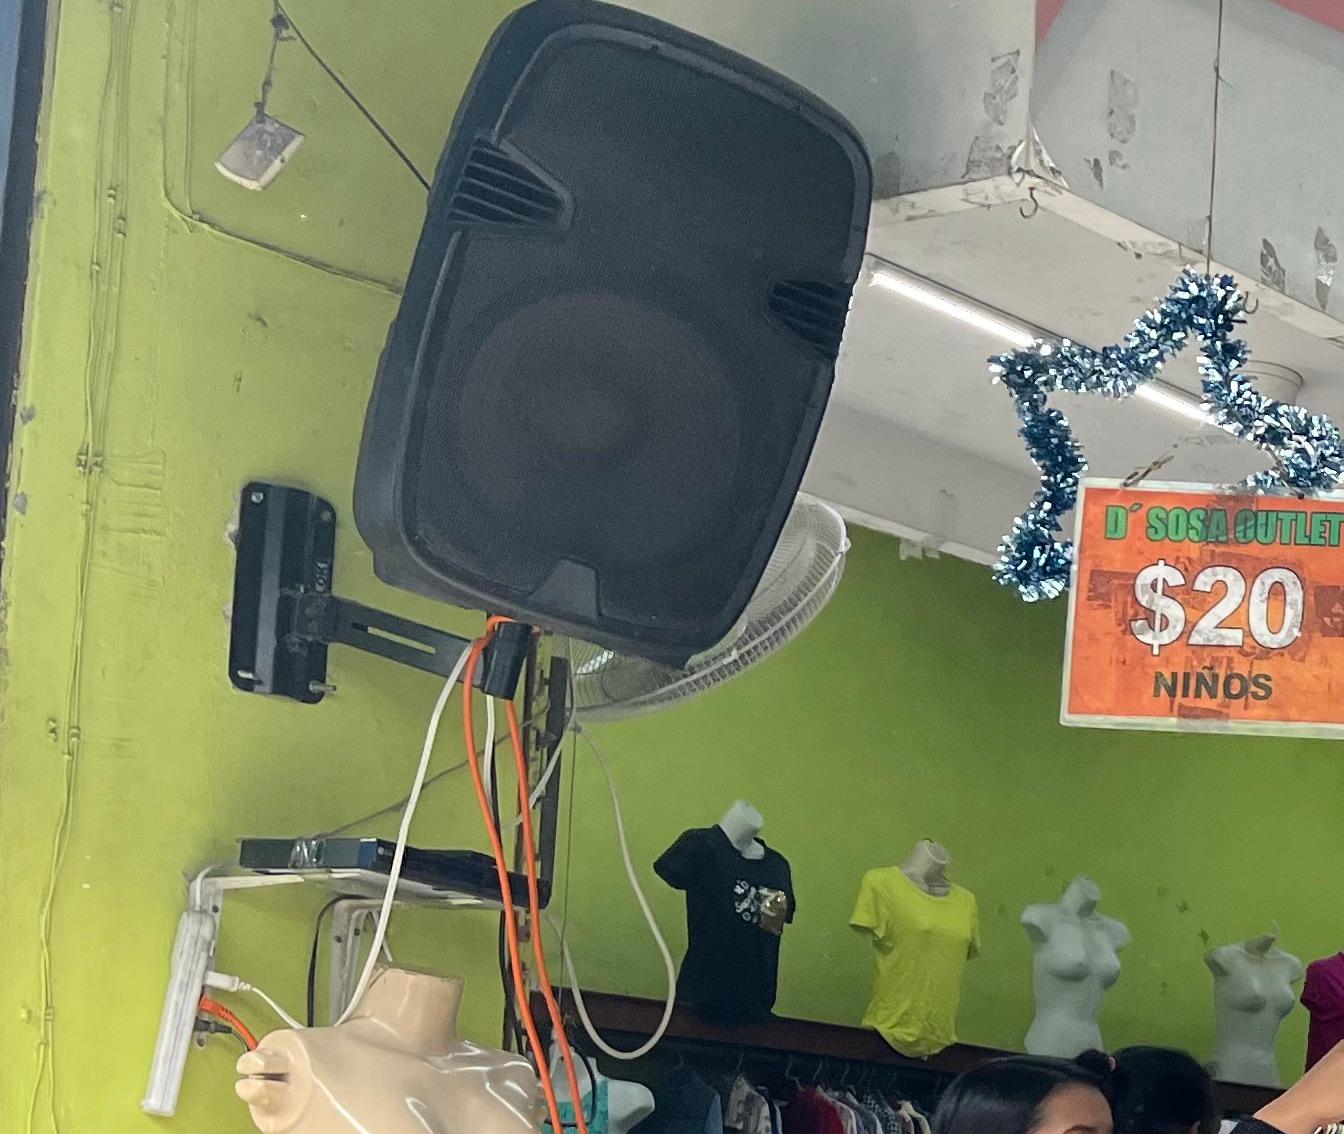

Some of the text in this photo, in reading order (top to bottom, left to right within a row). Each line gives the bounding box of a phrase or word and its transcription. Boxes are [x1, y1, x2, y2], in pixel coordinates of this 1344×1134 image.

[1146, 506, 1229, 544] SOSA
[1129, 558, 1304, 656] $20
[1153, 665, 1273, 701] NIÑOS
